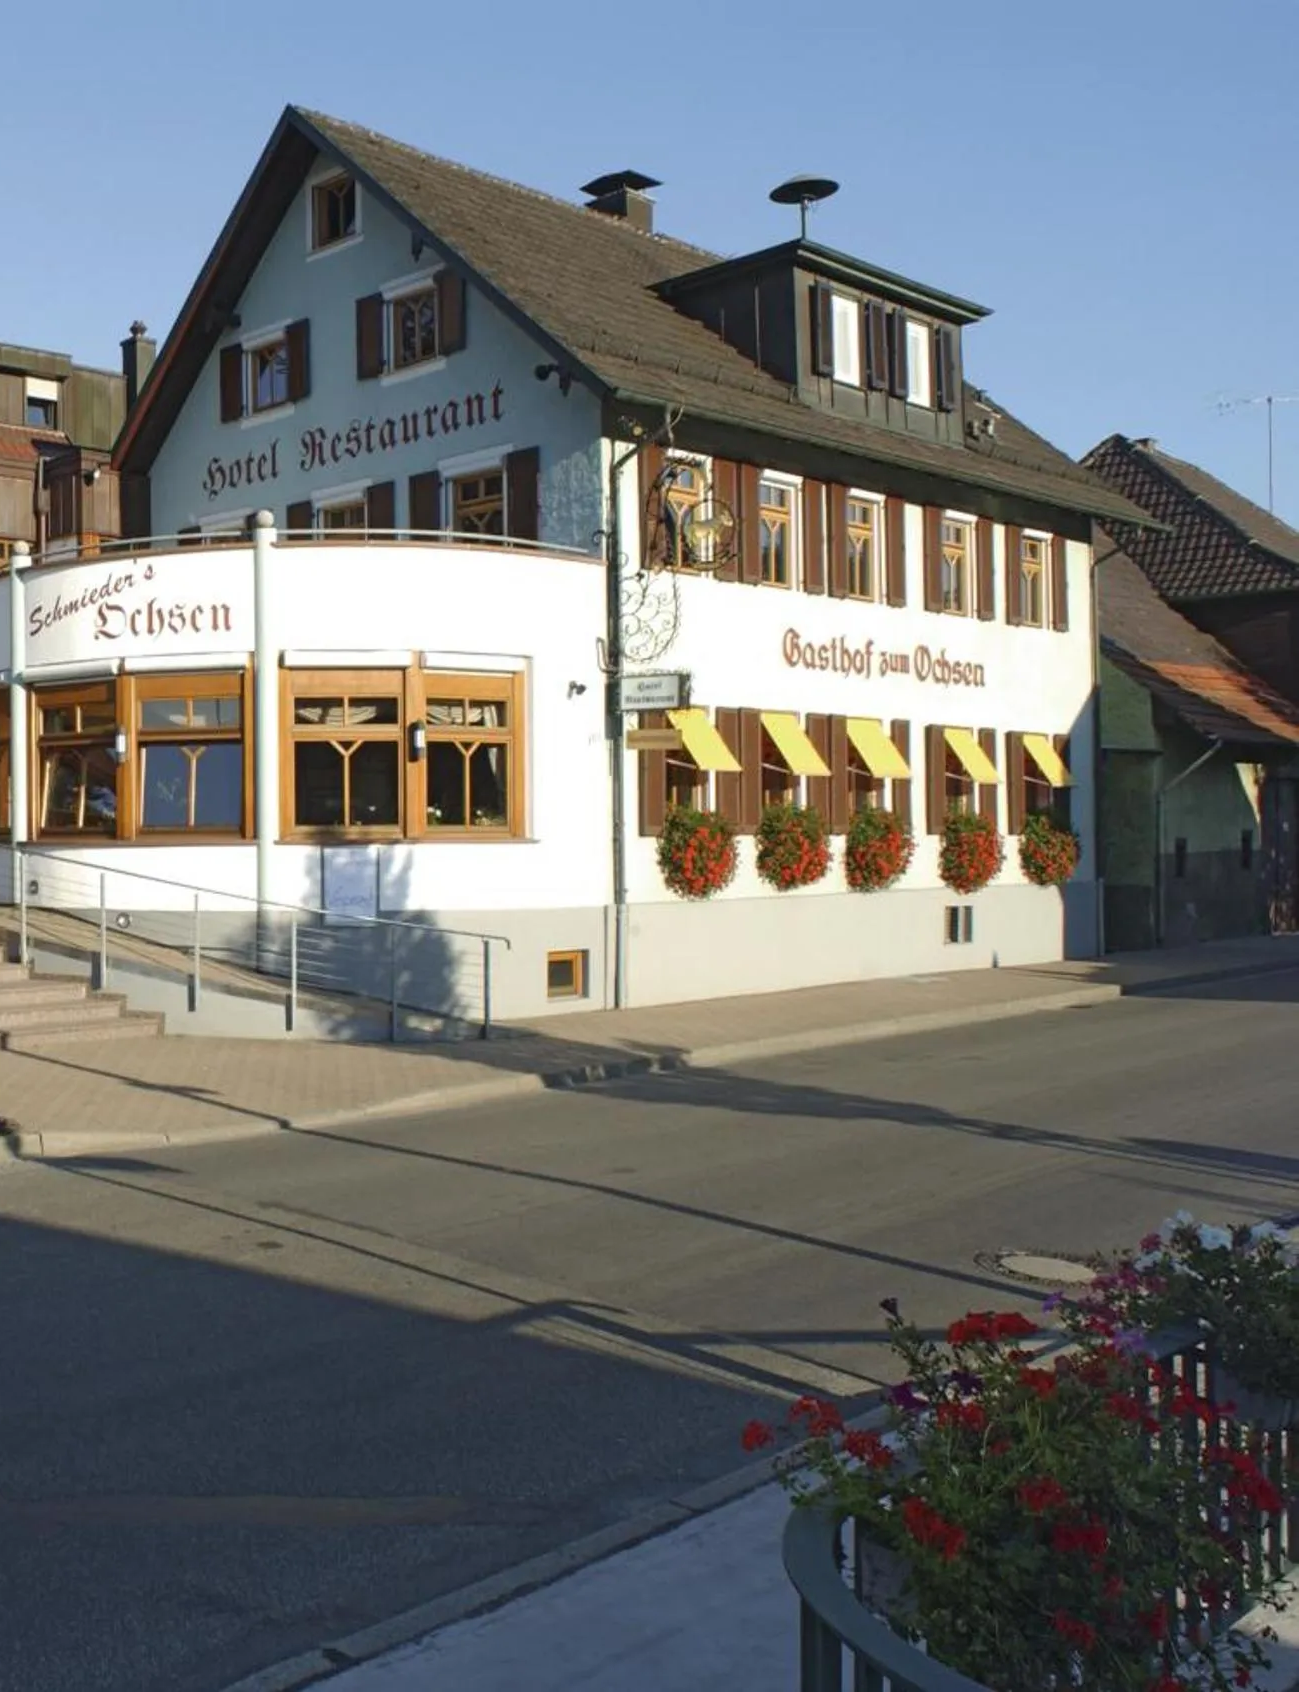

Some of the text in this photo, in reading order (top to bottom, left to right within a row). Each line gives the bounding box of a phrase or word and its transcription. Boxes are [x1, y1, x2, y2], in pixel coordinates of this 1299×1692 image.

[203, 379, 505, 500] Hotel Restaurant
[29, 557, 156, 637] Schmieder's
[93, 597, 233, 642] Ochsen
[783, 627, 986, 687] Gasthof zum Ochsen
